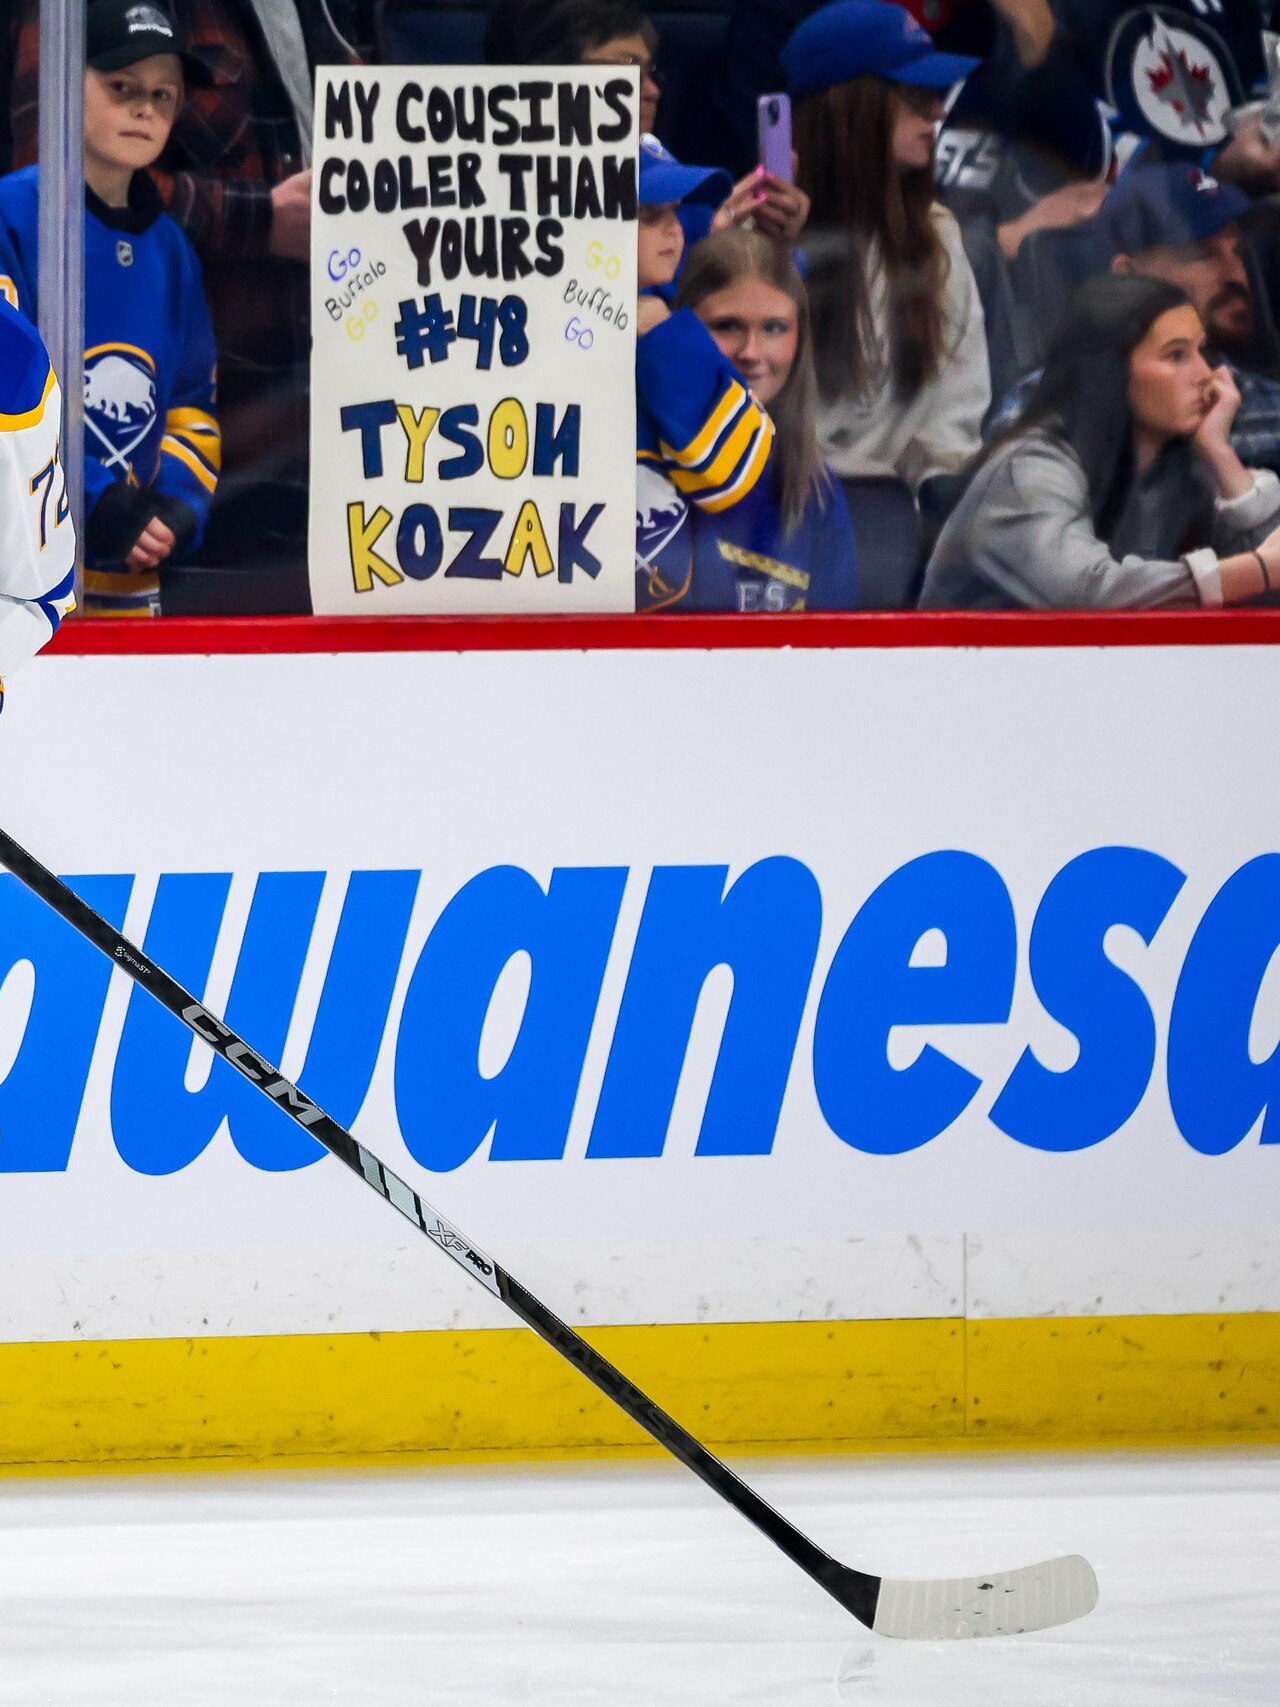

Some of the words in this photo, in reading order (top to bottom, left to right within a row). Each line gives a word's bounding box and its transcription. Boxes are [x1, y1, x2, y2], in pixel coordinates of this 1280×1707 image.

[324, 81, 380, 144] MY
[396, 79, 634, 147] COUSIN'S
[319, 153, 487, 215] COOLER
[499, 155, 638, 221] THAN
[402, 216, 565, 287] YOURS
[325, 259, 387, 322] Buffalo
[563, 279, 630, 332] Buffalo
[394, 293, 530, 371] #48
[340, 397, 581, 483] TYSON
[346, 500, 606, 594] KOZAK
[182, 1004, 326, 1126] CCM
[465, 1250, 493, 1276] PRO
